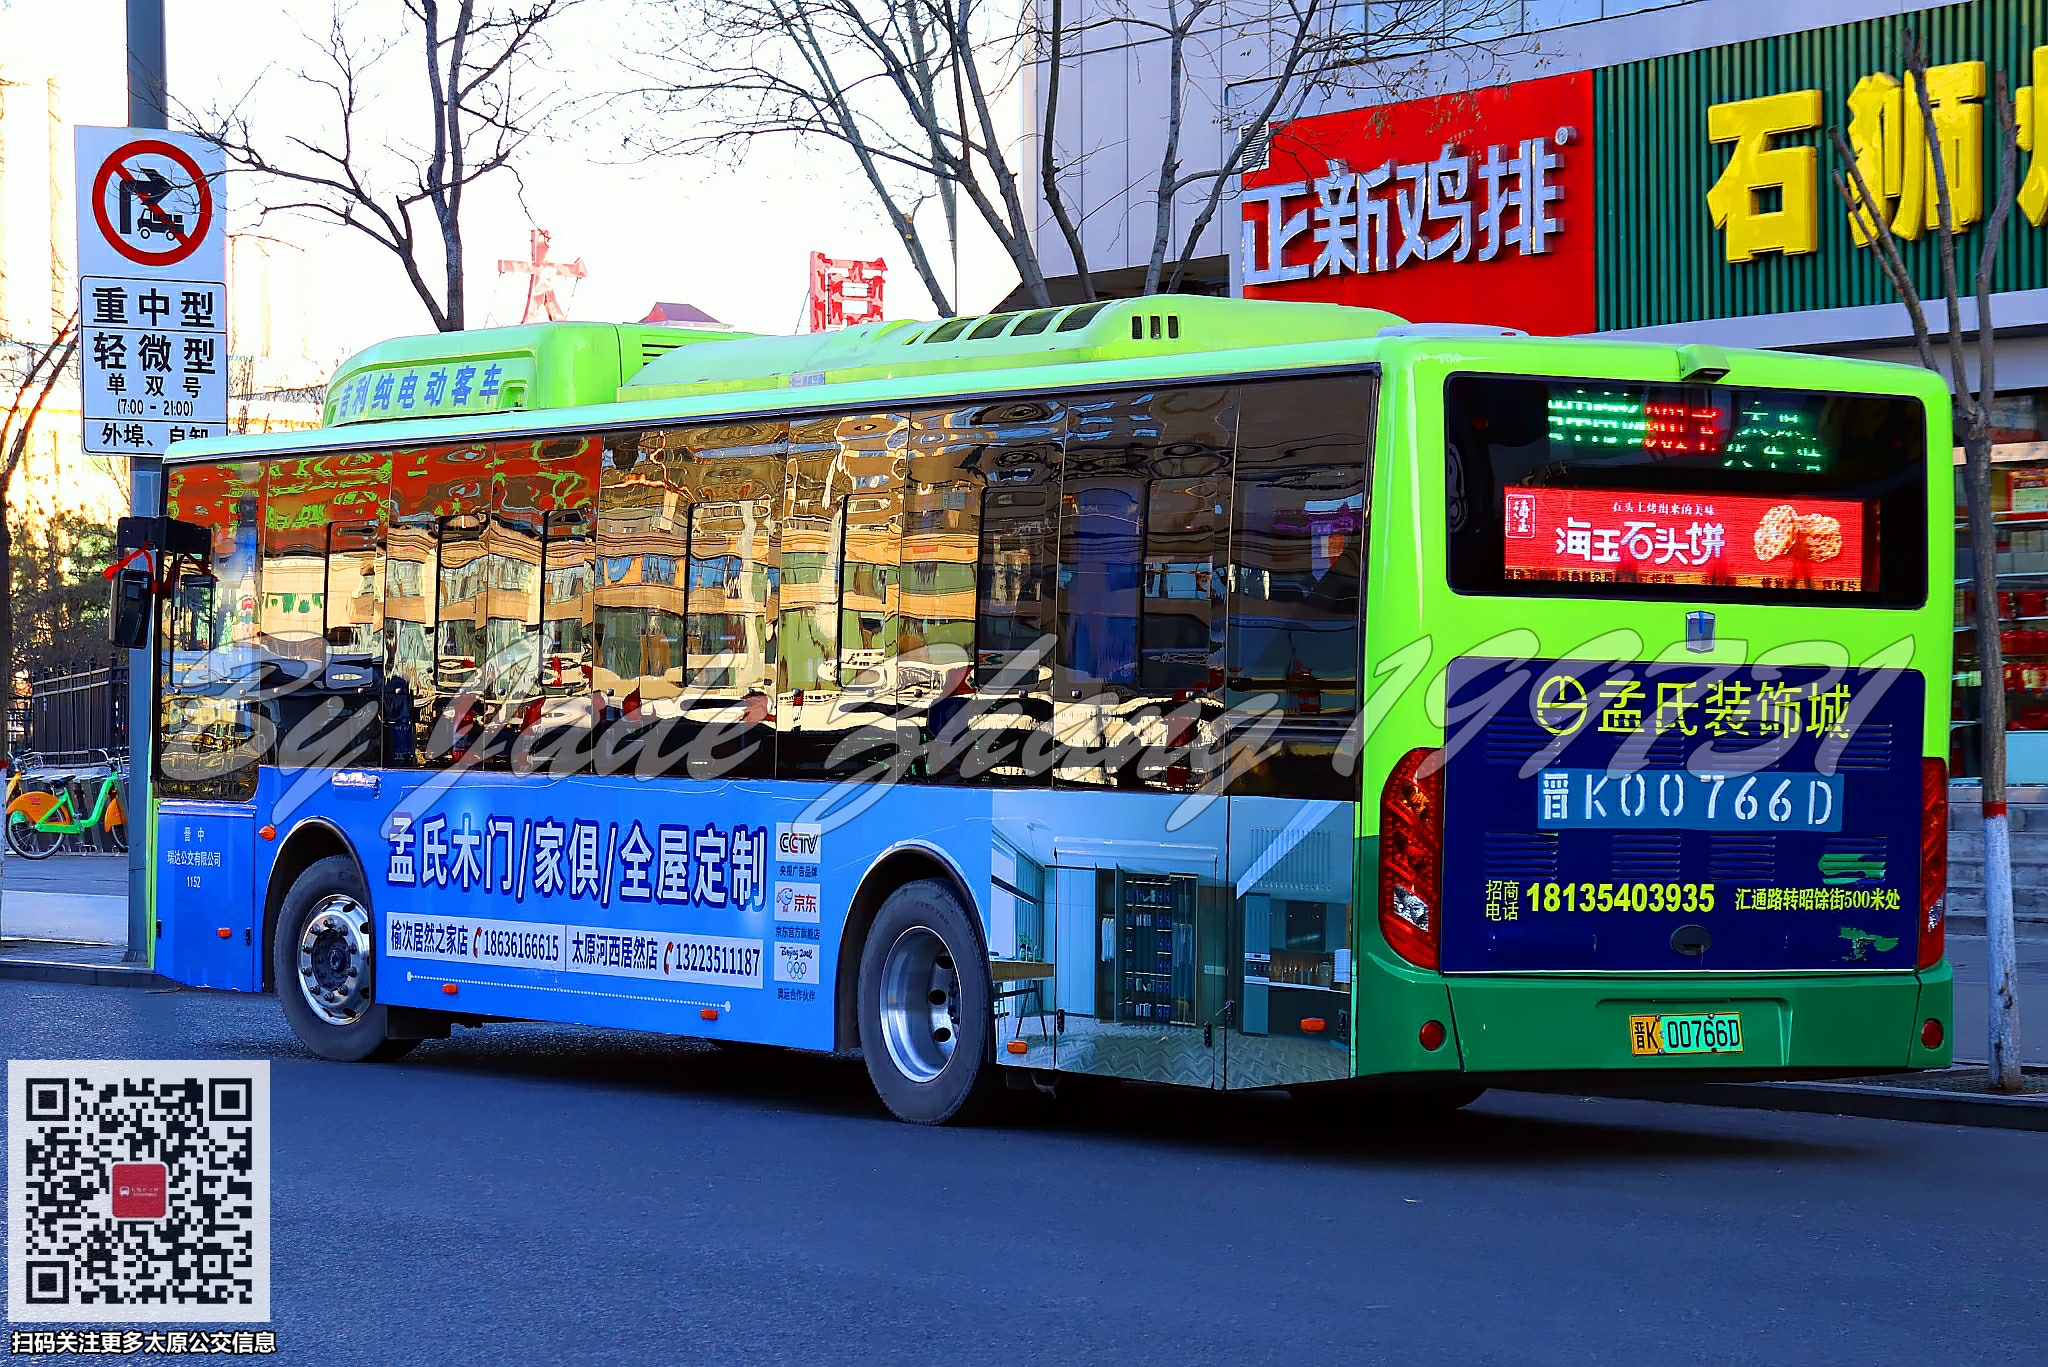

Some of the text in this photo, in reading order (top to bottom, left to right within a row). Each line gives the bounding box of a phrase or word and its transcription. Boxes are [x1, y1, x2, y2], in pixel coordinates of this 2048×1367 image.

[1242, 136, 1565, 286] 正新鸡排
[93, 286, 216, 328] 重中型
[93, 332, 216, 375] 轻微型
[107, 373, 202, 399] 单双号
[339, 363, 503, 417] 吉利纯电动客车
[1556, 516, 1726, 566] 海玉石头饼
[1597, 679, 1852, 739] 孟氏装饰城
[780, 832, 819, 855] CCTV
[187, 875, 201, 888] 1152
[1485, 879, 1520, 900] 招商
[1526, 883, 1715, 912] 18135403935
[794, 893, 817, 913] 京东
[1485, 901, 1520, 921] 电话
[391, 919, 559, 961] 榆次居然之家店 18636166615
[572, 932, 761, 977] 太原河西居然店 13223511187
